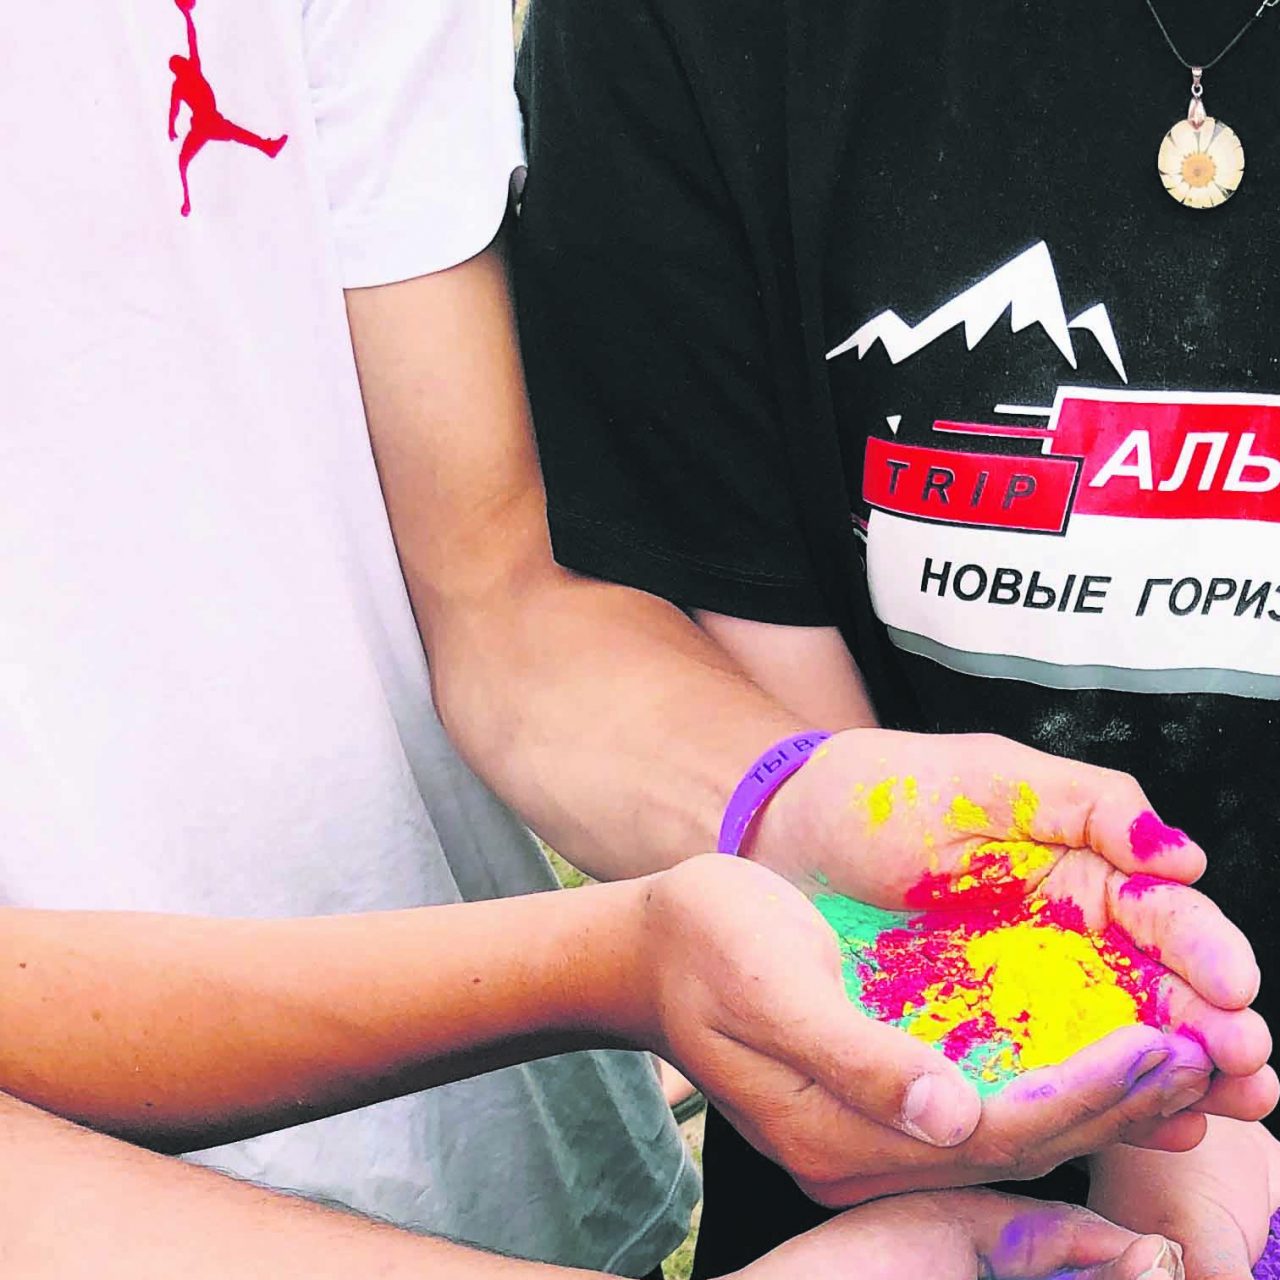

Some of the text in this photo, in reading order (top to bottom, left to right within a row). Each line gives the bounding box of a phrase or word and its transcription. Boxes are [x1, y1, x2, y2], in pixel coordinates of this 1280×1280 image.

[886, 459, 1037, 510] TRIP
[919, 557, 1113, 614] НОВЫЕ
[750, 750, 789, 784] ТЫ
